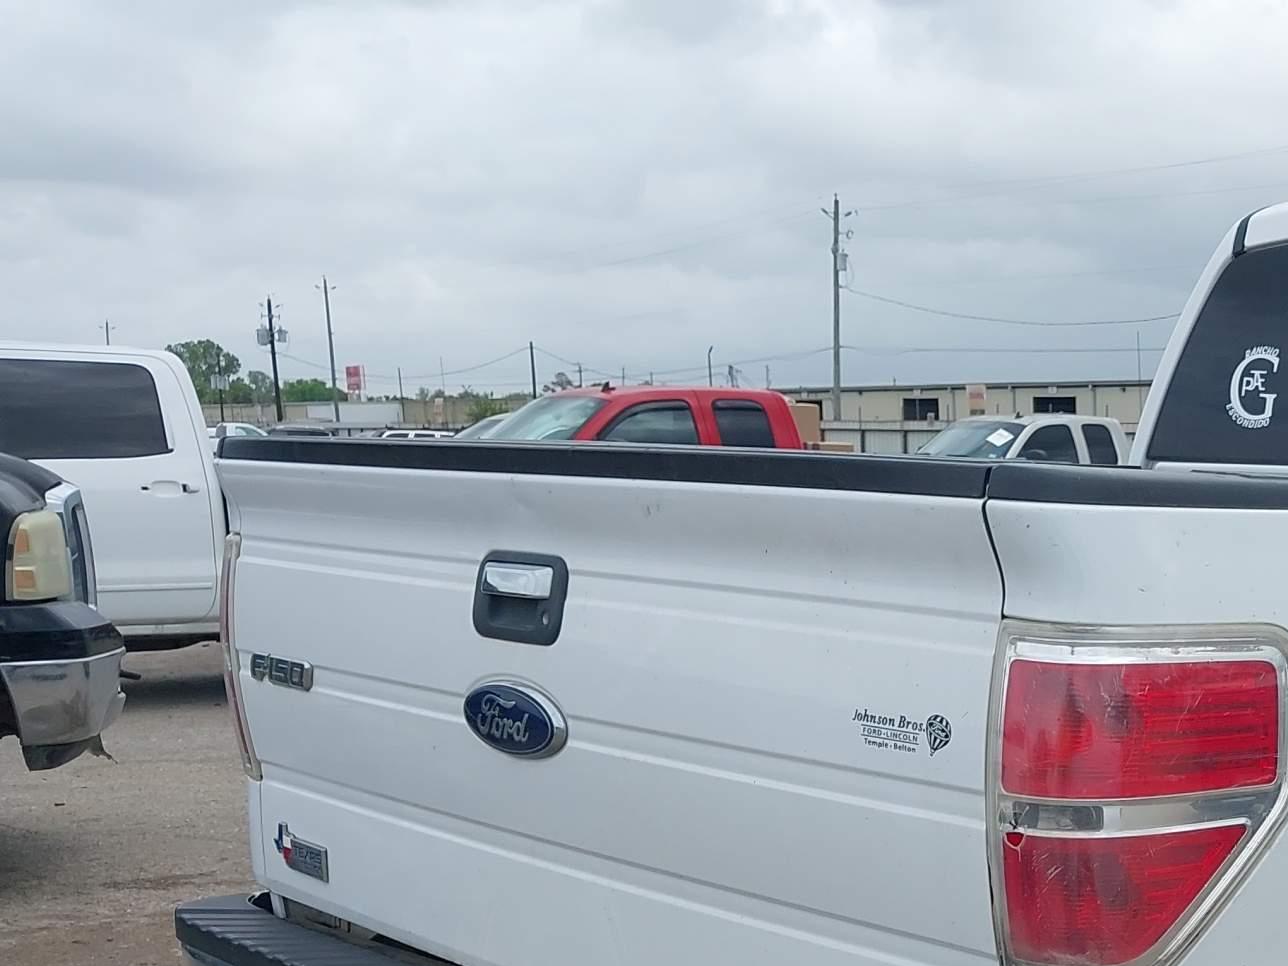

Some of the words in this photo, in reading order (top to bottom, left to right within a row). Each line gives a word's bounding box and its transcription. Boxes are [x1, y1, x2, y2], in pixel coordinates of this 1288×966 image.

[476, 693, 530, 742] Ford
[852, 708, 896, 727] Johnson
[897, 715, 926, 732] Bros.
